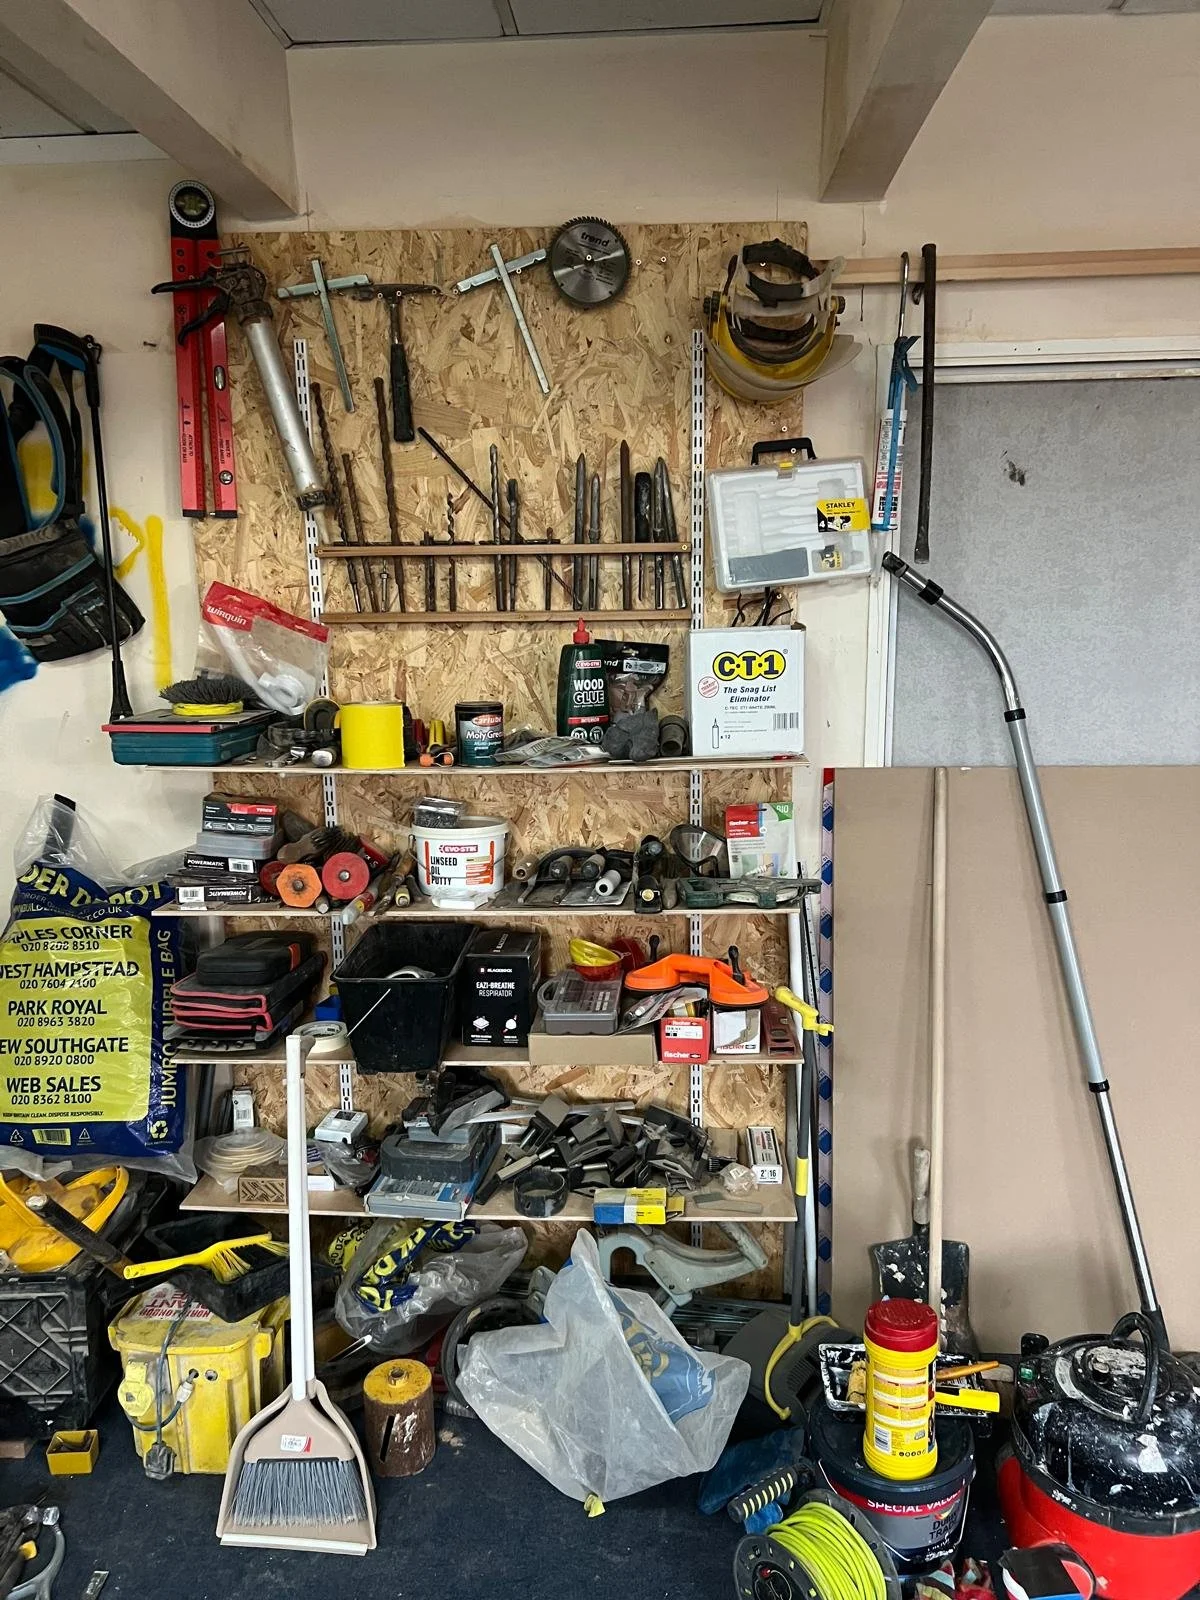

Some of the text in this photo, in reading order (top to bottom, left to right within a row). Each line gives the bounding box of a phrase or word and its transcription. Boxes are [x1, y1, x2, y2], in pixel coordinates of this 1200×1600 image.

[581, 232, 610, 246] trend
[574, 679, 604, 691] WOOD
[740, 686, 759, 694] Snag
[573, 690, 604, 704] GLUE
[466, 730, 486, 741] Moly
[187, 858, 226, 867] POWERMATIC
[430, 856, 458, 866] LINSEED
[431, 866, 441, 876] OIL
[431, 877, 451, 885] PUTTY
[61, 925, 132, 939] CORNER
[22, 940, 40, 952] 020
[72, 940, 99, 950] 8510
[158, 930, 175, 963] BAG
[33, 961, 140, 977] HAMPSTEAD
[20, 979, 38, 989] 020
[41, 979, 66, 988] 7604
[8, 1000, 107, 1016] PARK ROYAL
[17, 1016, 95, 1027] 020 8963 3820
[24, 1037, 128, 1054] SOUTHGATE
[14, 1055, 94, 1066] 020 8920 0800
[6, 1076, 101, 1093] WEB SALES
[12, 1094, 92, 1105] 020 8362 8100
[867, 1499, 923, 1513] SPECIAL
